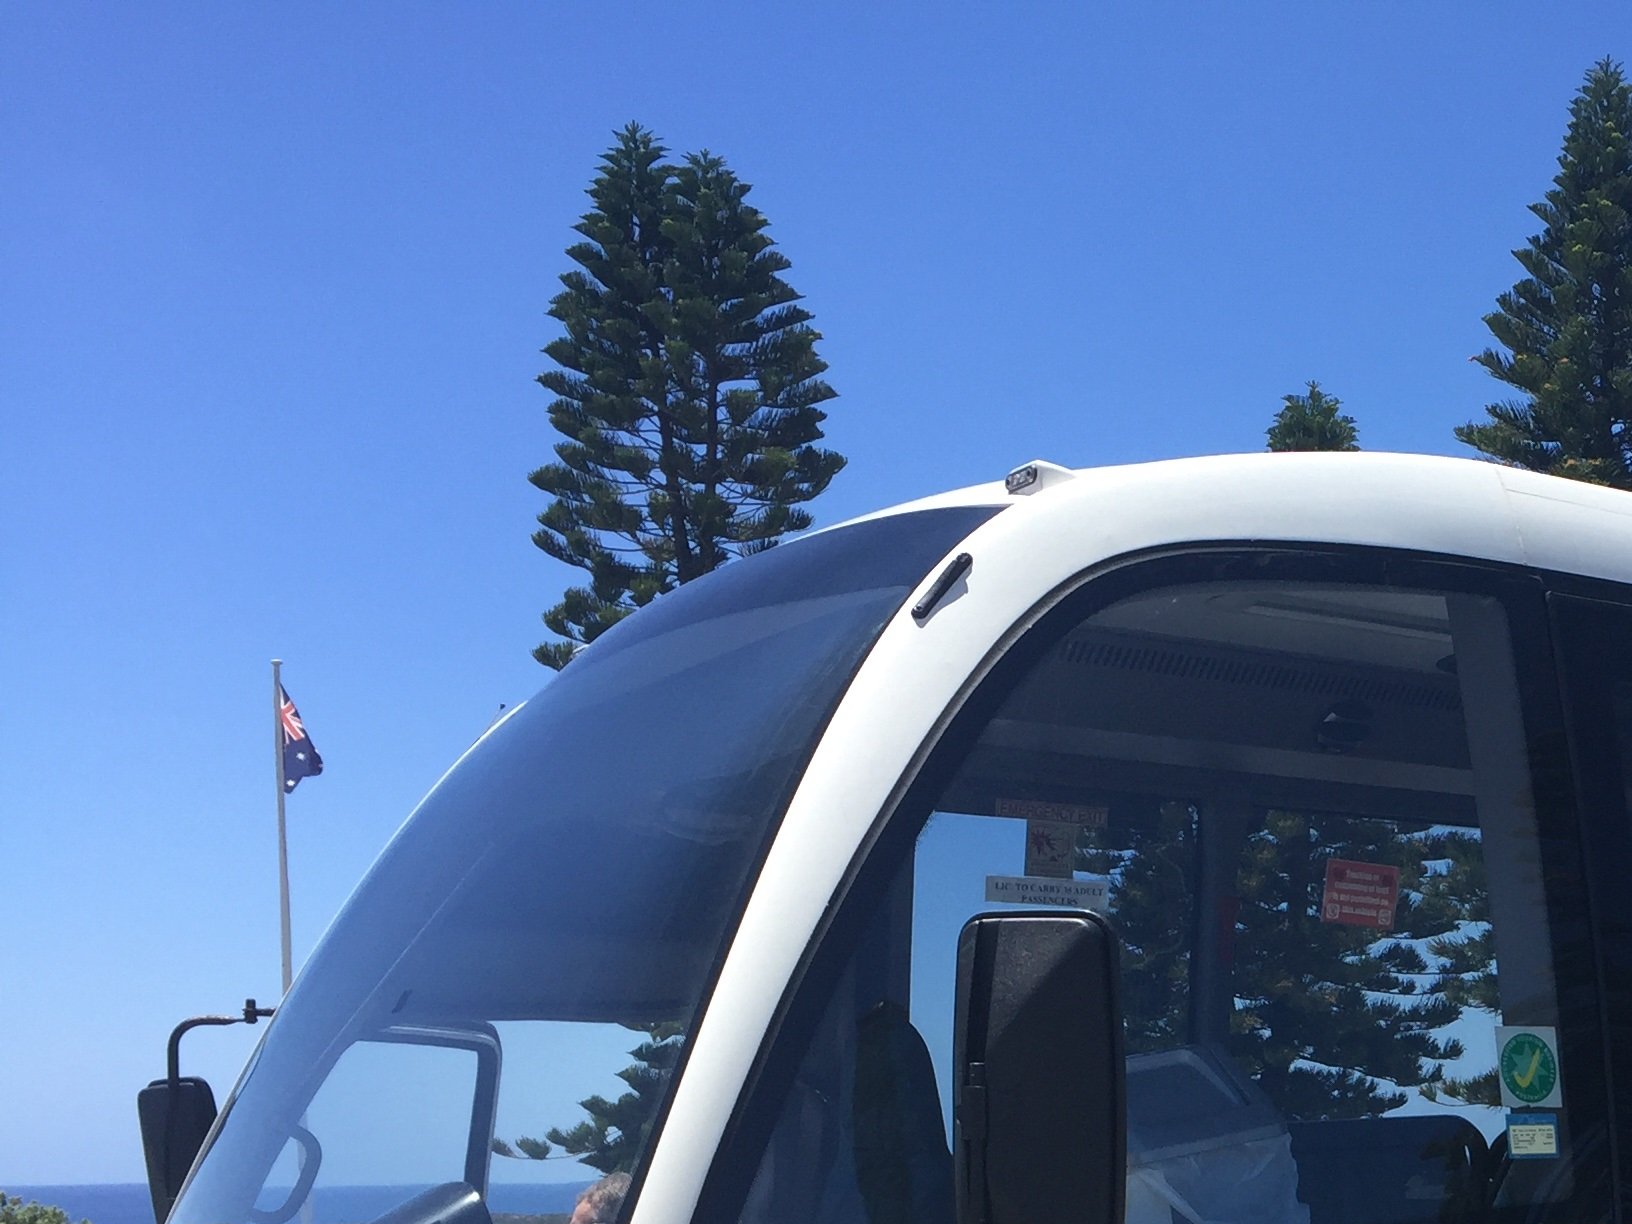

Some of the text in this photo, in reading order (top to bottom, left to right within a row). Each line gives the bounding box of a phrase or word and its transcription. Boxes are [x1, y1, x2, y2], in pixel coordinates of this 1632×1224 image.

[1001, 802, 1105, 825] EMERGENCY EXIT
[1030, 883, 1060, 894] CARRY
[1075, 887, 1104, 897] ADULT
